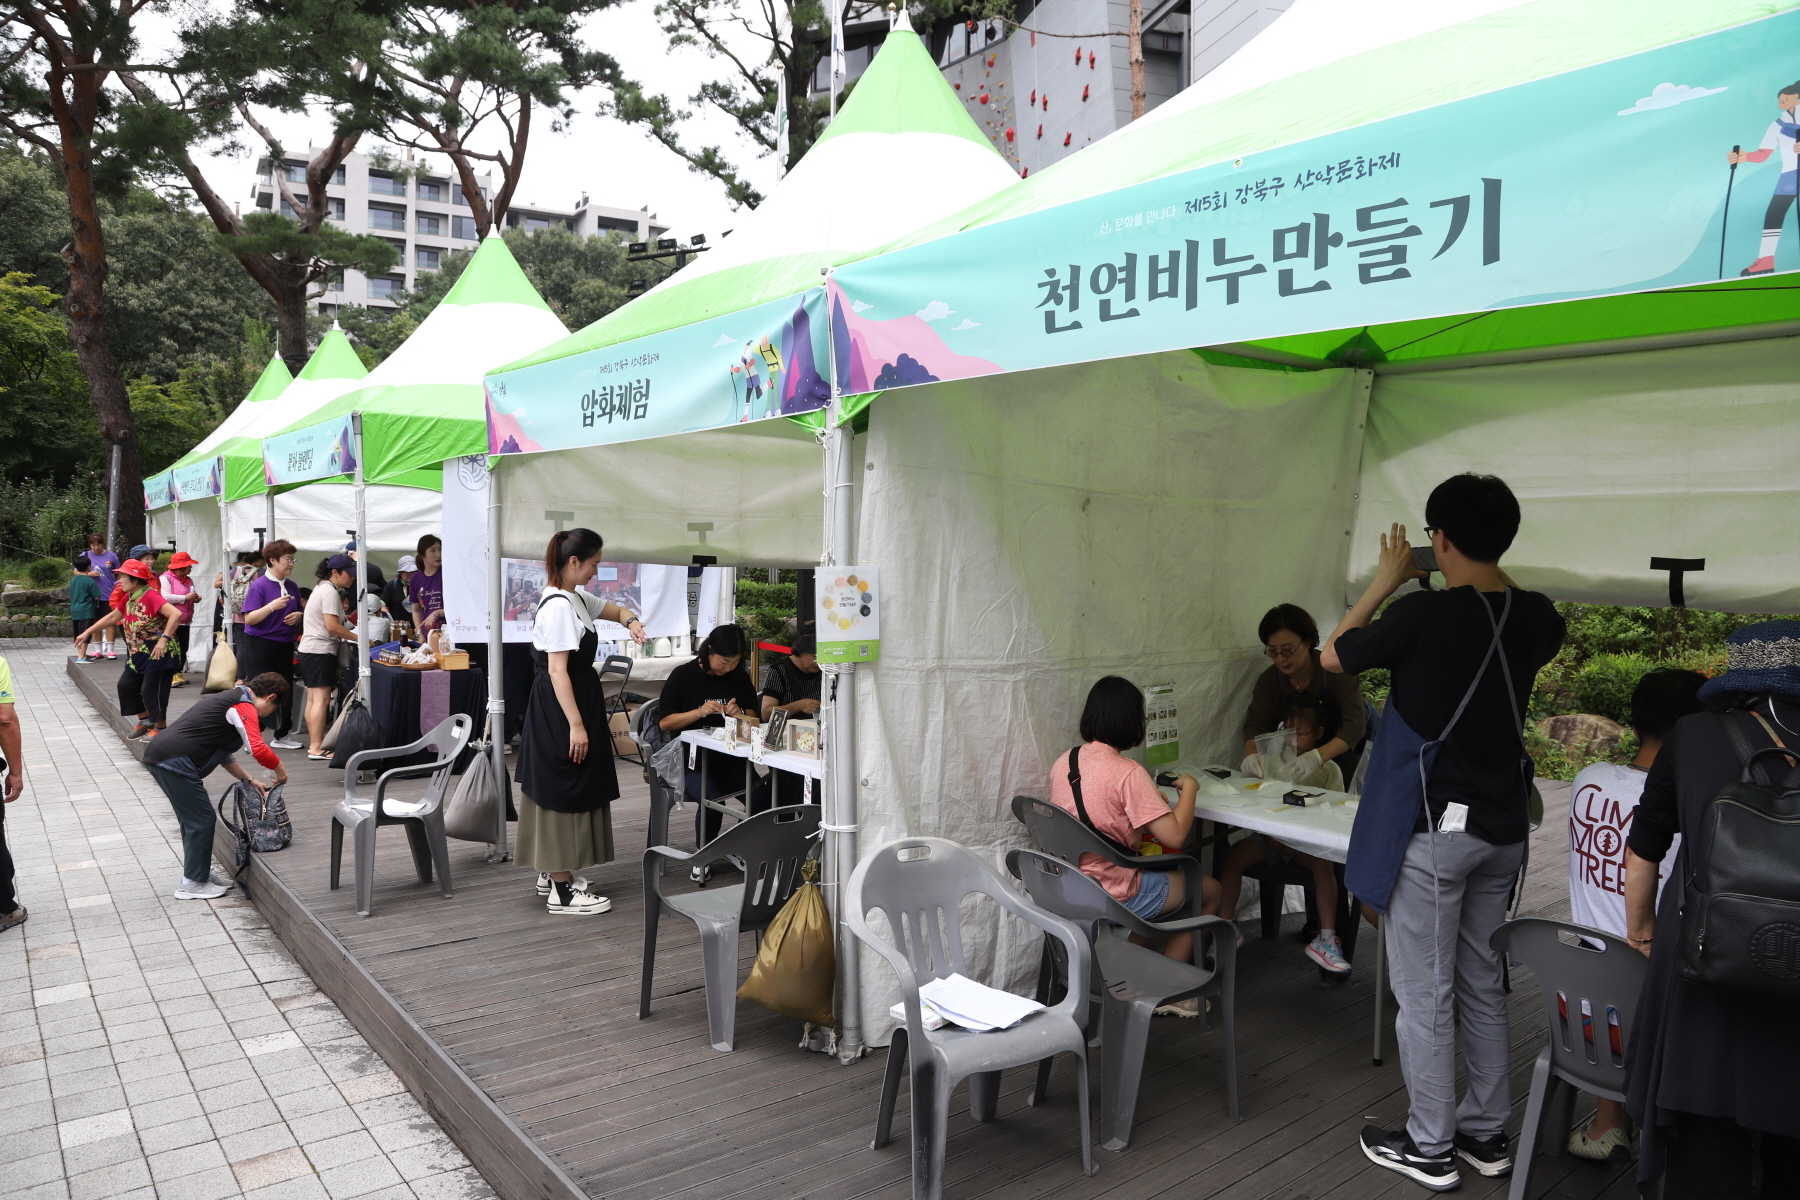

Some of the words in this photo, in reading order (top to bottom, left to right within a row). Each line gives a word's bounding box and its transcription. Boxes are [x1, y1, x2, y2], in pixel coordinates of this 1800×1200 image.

[1114, 212, 1144, 232] 문화를
[1145, 204, 1177, 224] 만나다
[1184, 191, 1228, 215] 제5회
[1234, 176, 1286, 206] 강북구
[1293, 151, 1401, 192] 산악문화제
[1034, 177, 1503, 335] 천연비누만들기
[581, 378, 650, 428] 암화체험
[1573, 784, 1635, 831] CLIM
[1575, 847, 1628, 897] TREE
